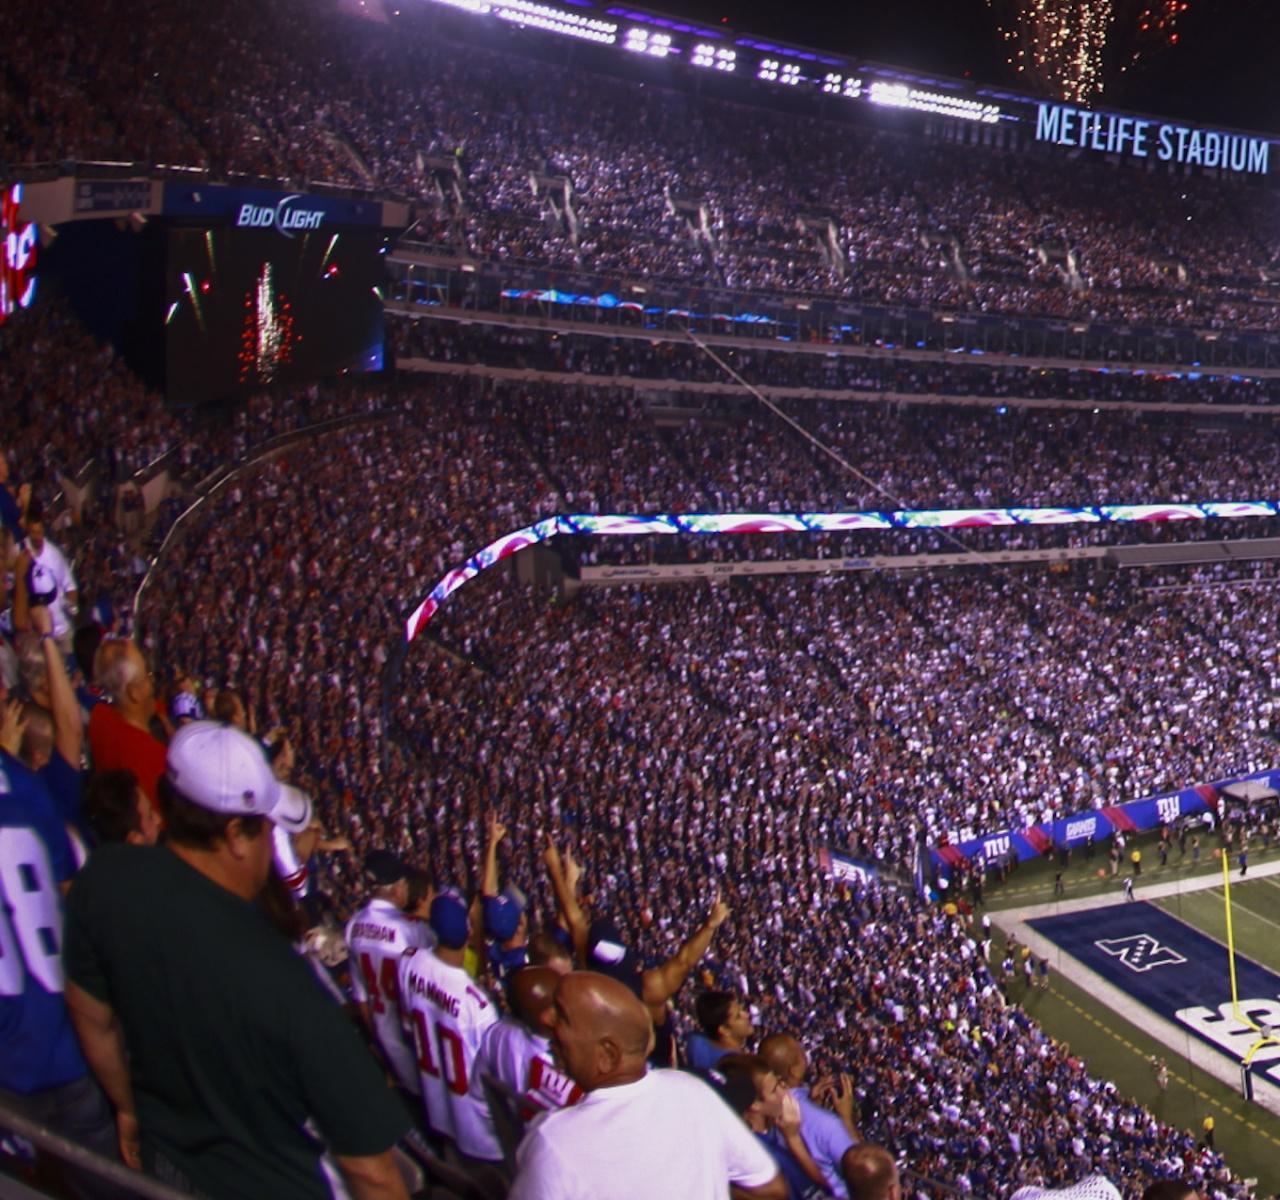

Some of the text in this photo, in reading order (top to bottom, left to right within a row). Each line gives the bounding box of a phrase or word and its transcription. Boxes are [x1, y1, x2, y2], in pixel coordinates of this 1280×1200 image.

[1036, 104, 1269, 174] METLIFE STADIUM
[238, 204, 326, 230] BUD LIGHT
[408, 970, 461, 1019] MANNING
[410, 1007, 469, 1097] 10
